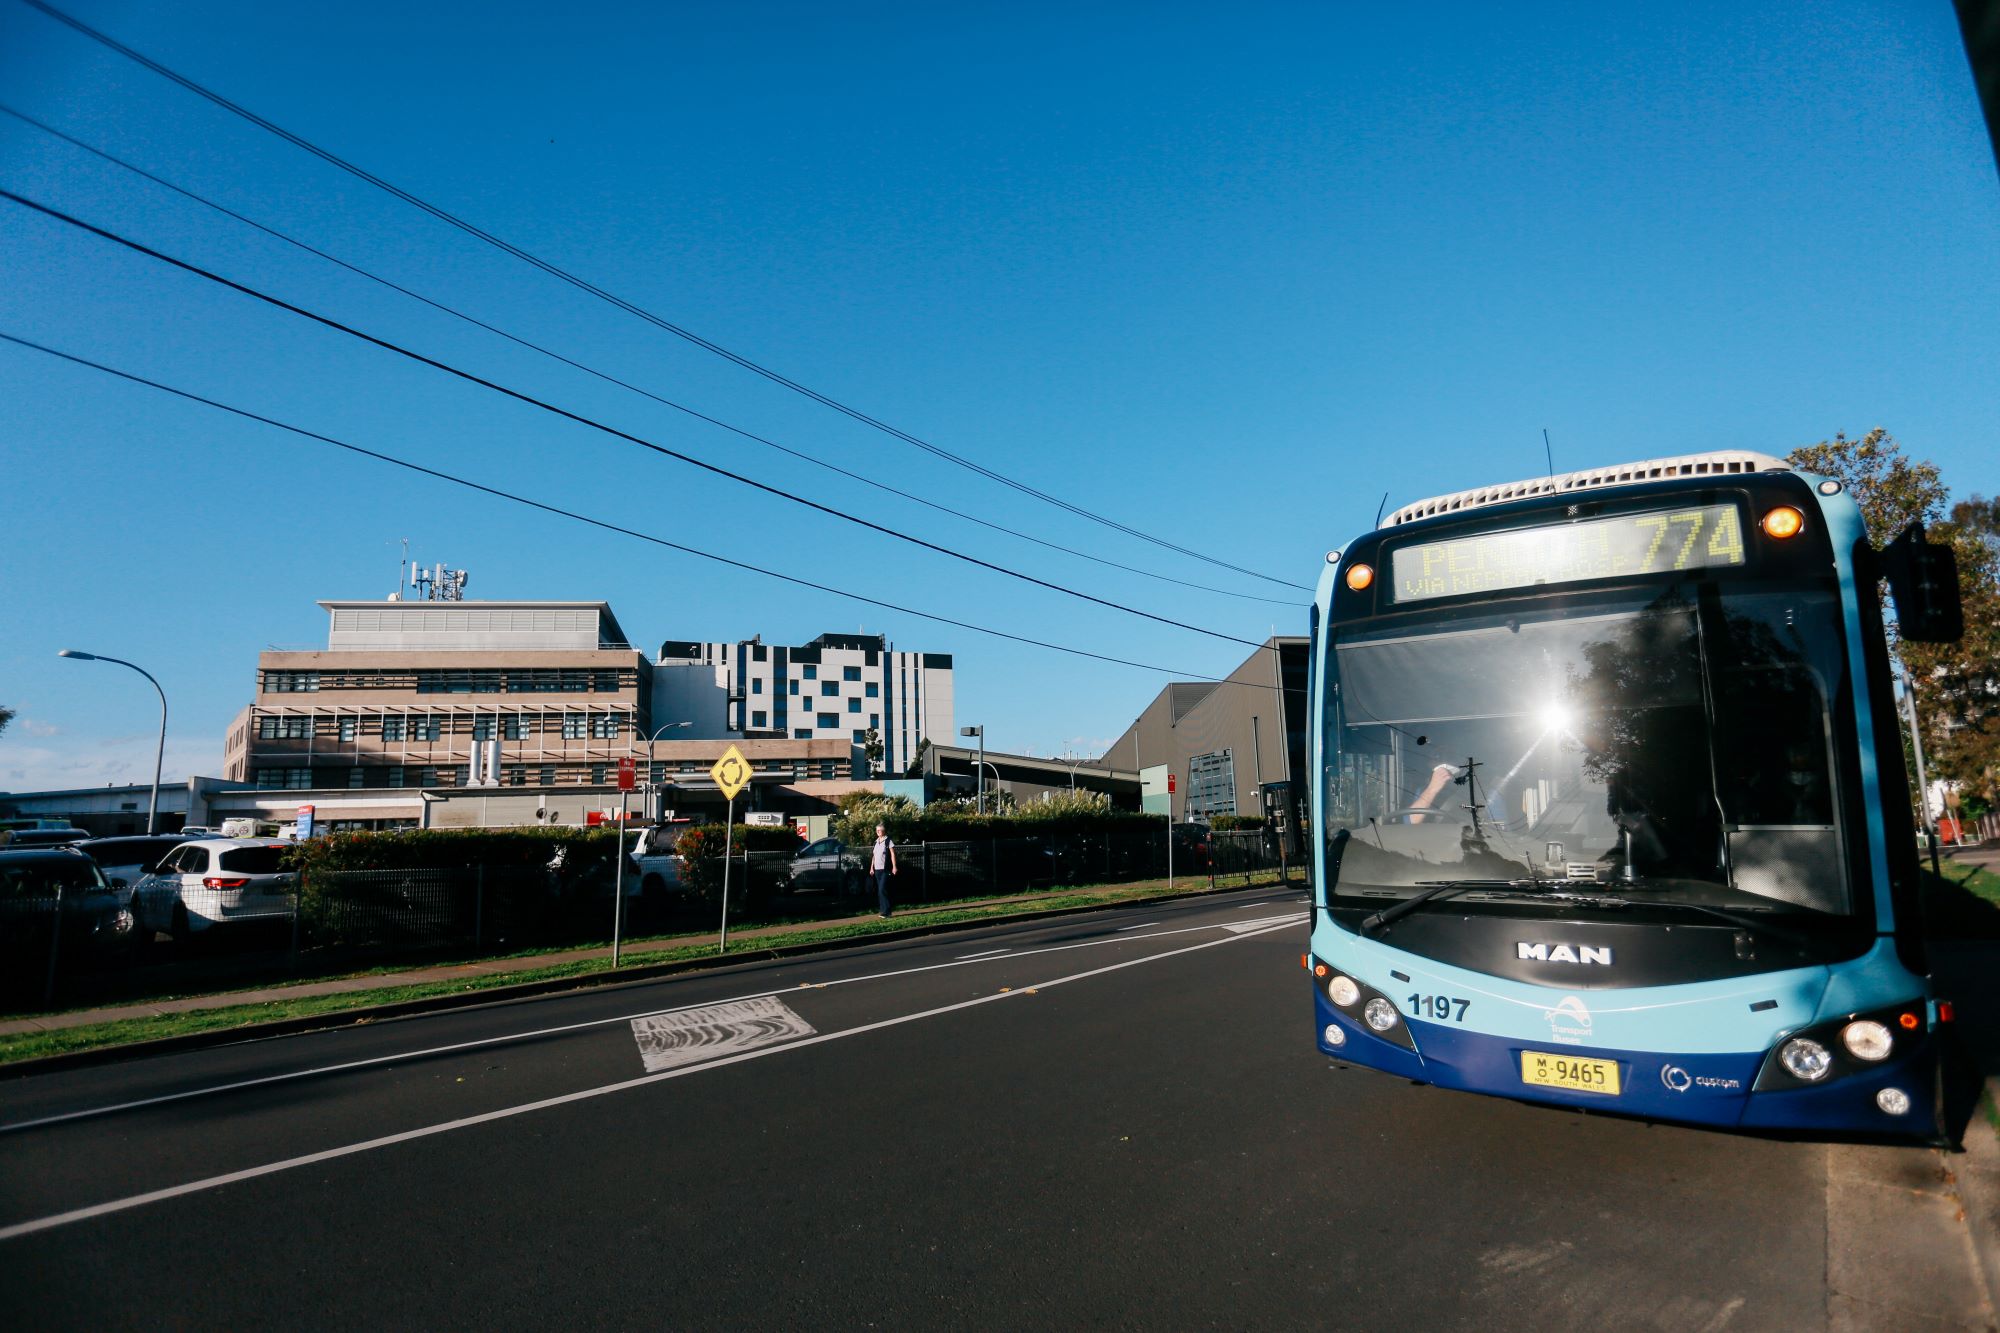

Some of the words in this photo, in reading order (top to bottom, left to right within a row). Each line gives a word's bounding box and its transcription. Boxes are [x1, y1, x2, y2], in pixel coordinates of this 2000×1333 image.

[1421, 524, 1605, 576] PENH
[1636, 507, 1741, 573] 774
[1405, 577, 1446, 595] VIA
[1517, 942, 1612, 965] MAN
[1408, 993, 1471, 1022] 1197
[1552, 1024, 1592, 1036] Transport
[1553, 1079, 1578, 1087] SOUTH
